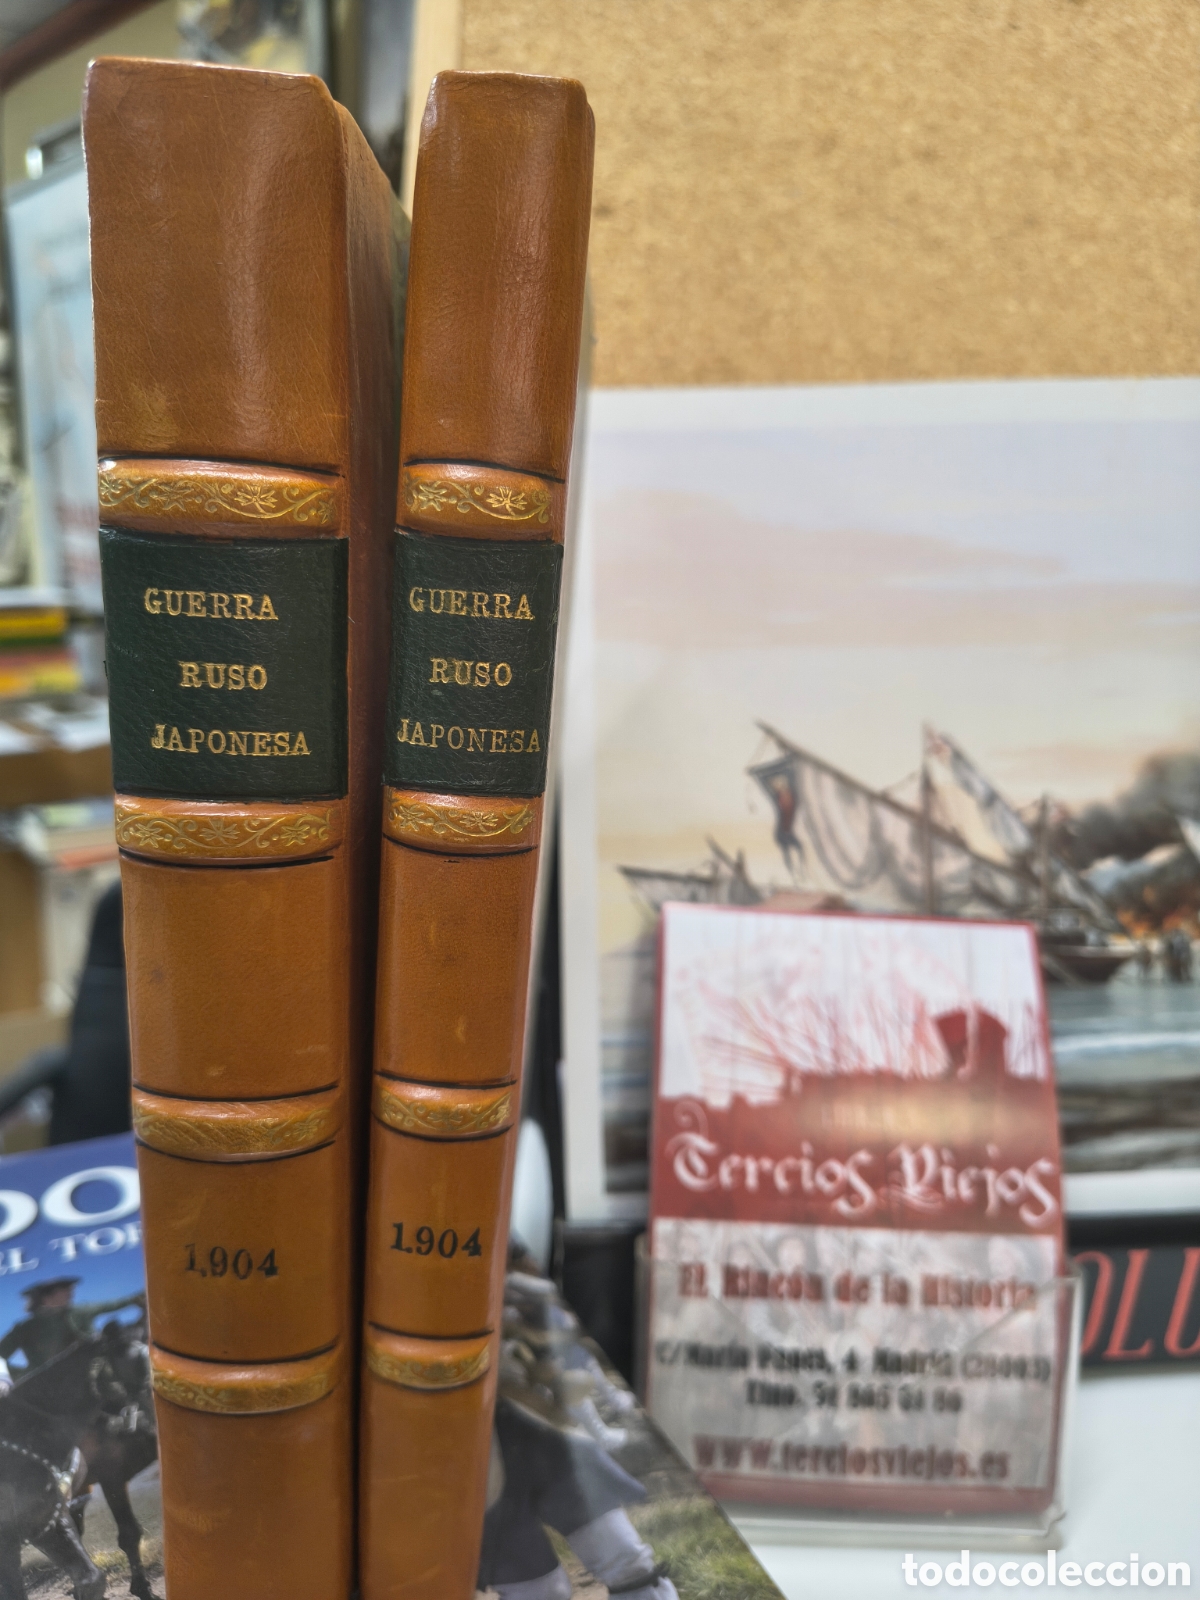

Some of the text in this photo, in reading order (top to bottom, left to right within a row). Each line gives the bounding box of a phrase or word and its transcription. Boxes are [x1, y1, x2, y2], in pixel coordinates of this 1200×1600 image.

[144, 587, 279, 621] GUERRA
[409, 586, 536, 621] GUERRA
[178, 660, 268, 690] RUSO
[429, 657, 513, 687] RUSO
[151, 723, 312, 756] JAPONESA
[397, 718, 541, 753] JAPONESA
[666, 1124, 1058, 1228] Tercios Viejos
[391, 1222, 482, 1258] 1.904
